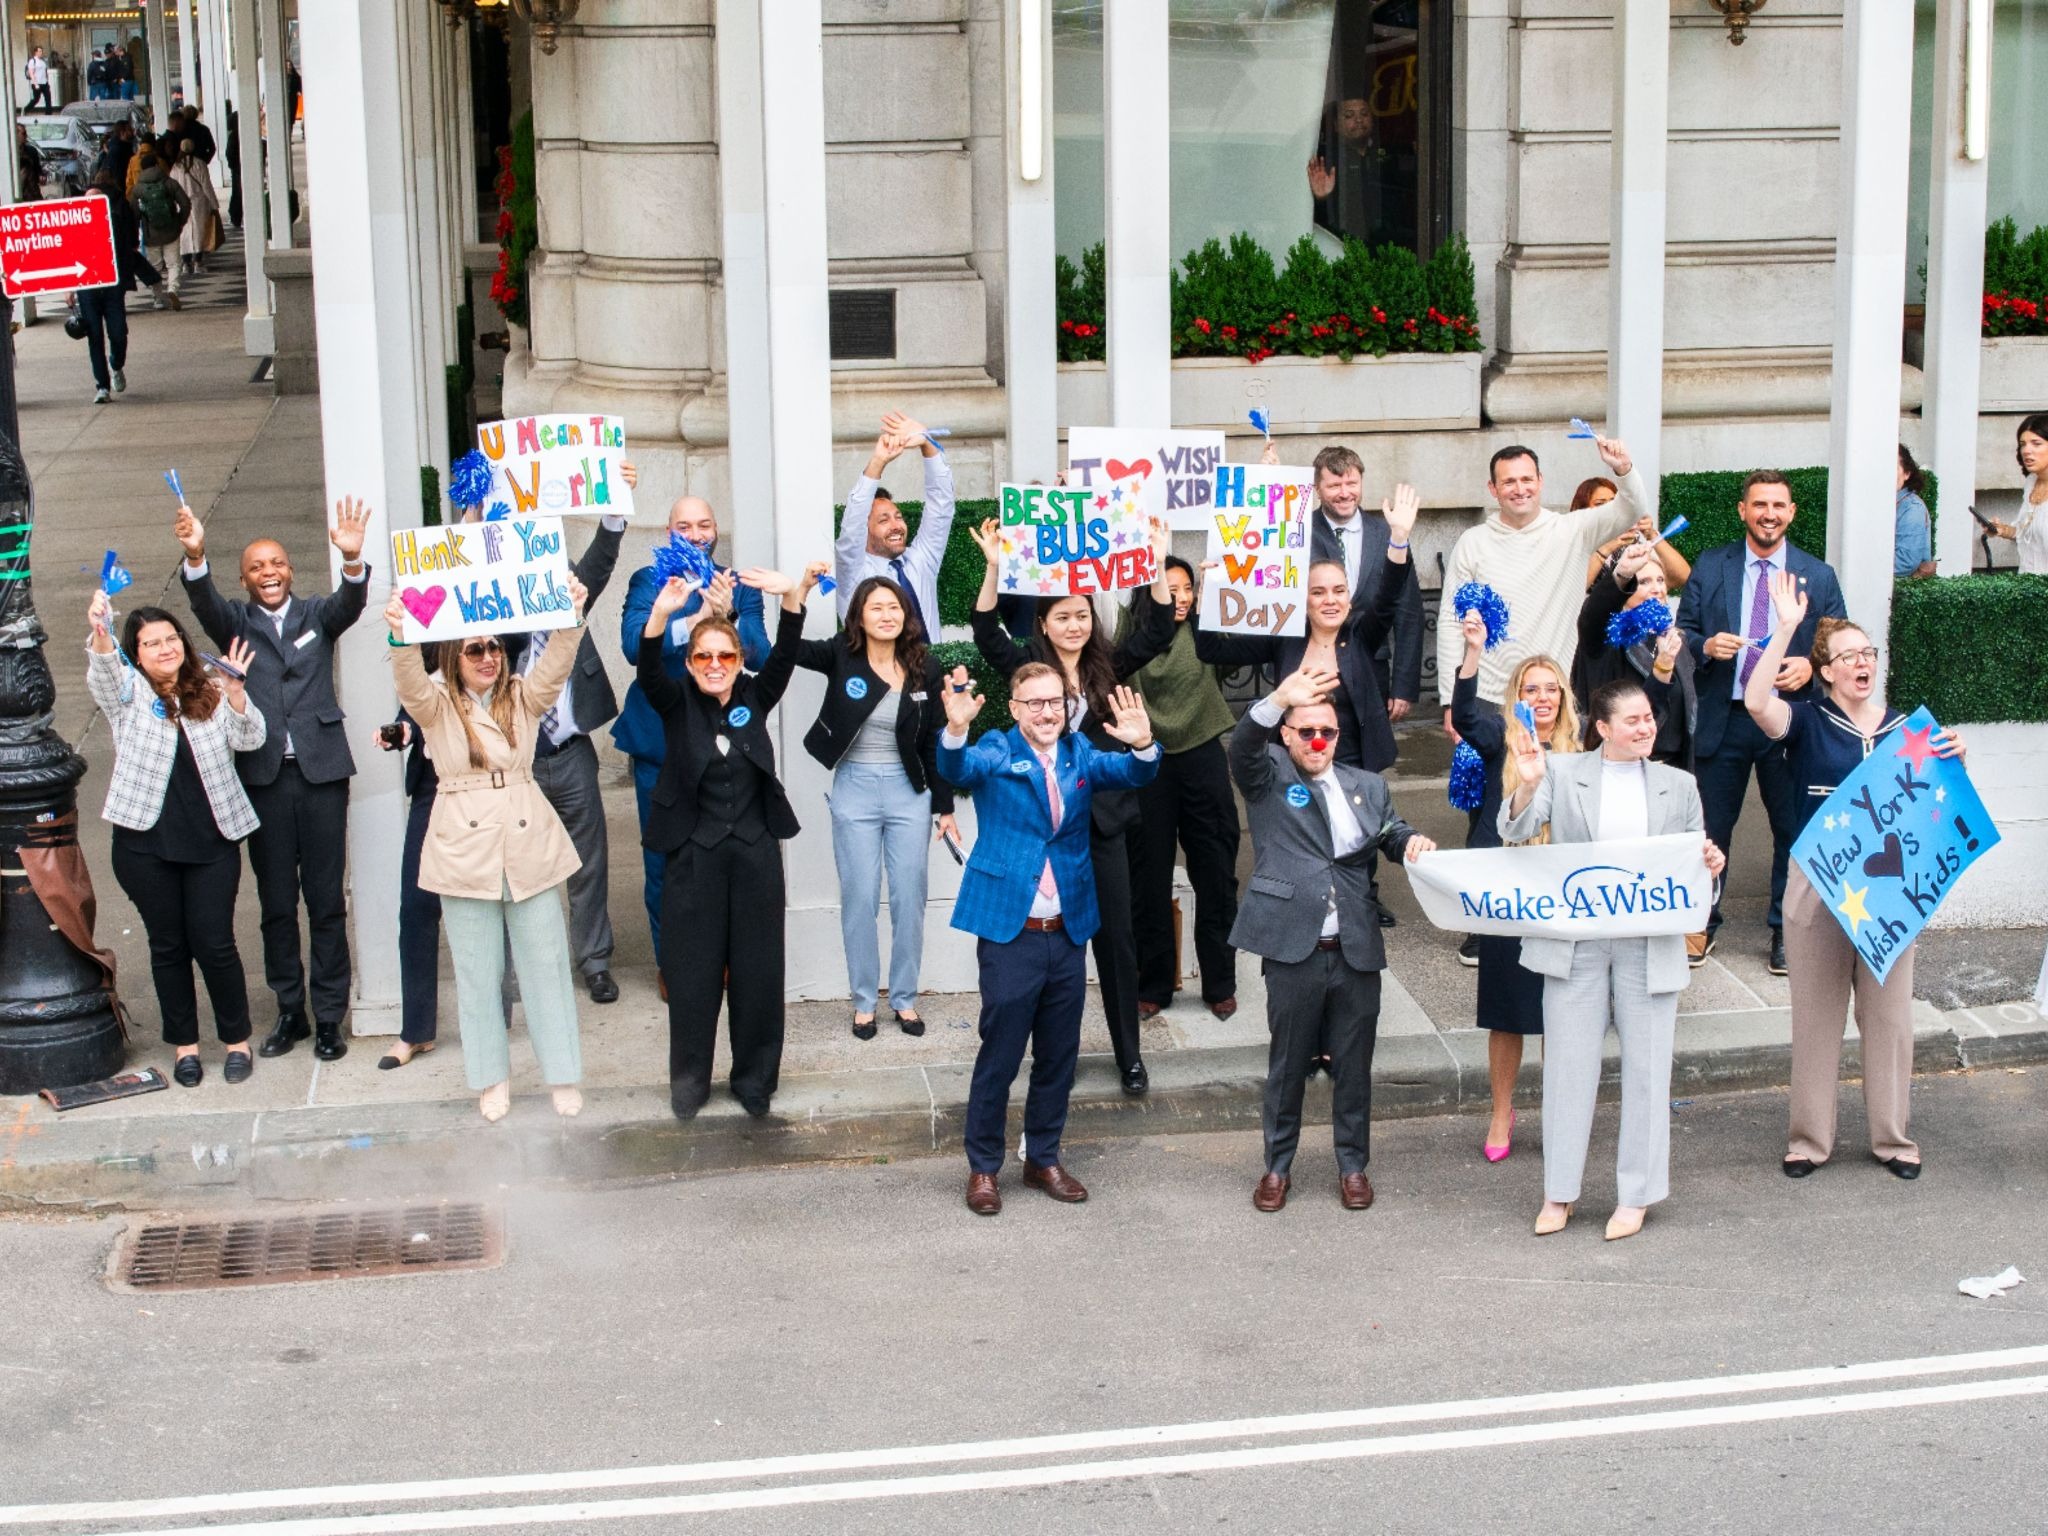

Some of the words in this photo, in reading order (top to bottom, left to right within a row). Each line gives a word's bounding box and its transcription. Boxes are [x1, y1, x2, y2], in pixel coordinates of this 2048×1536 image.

[1, 215, 21, 233] NO
[24, 207, 92, 231] STANDING
[5, 233, 63, 254] Anytime
[480, 424, 506, 461] U
[590, 416, 623, 448] The
[1158, 446, 1221, 475] WISH
[1002, 487, 1093, 526] BEST
[1166, 478, 1212, 511] KID
[1214, 466, 1315, 525] Happy
[393, 527, 472, 576] Honk
[1036, 518, 1110, 565] BUS
[1214, 514, 1304, 550] World
[1068, 545, 1157, 595] EVER!
[1222, 553, 1298, 589] Wish
[517, 570, 572, 616] Kids
[1219, 588, 1296, 635] Day
[1807, 834, 1862, 899] New
[1857, 916, 1908, 973] Wish
